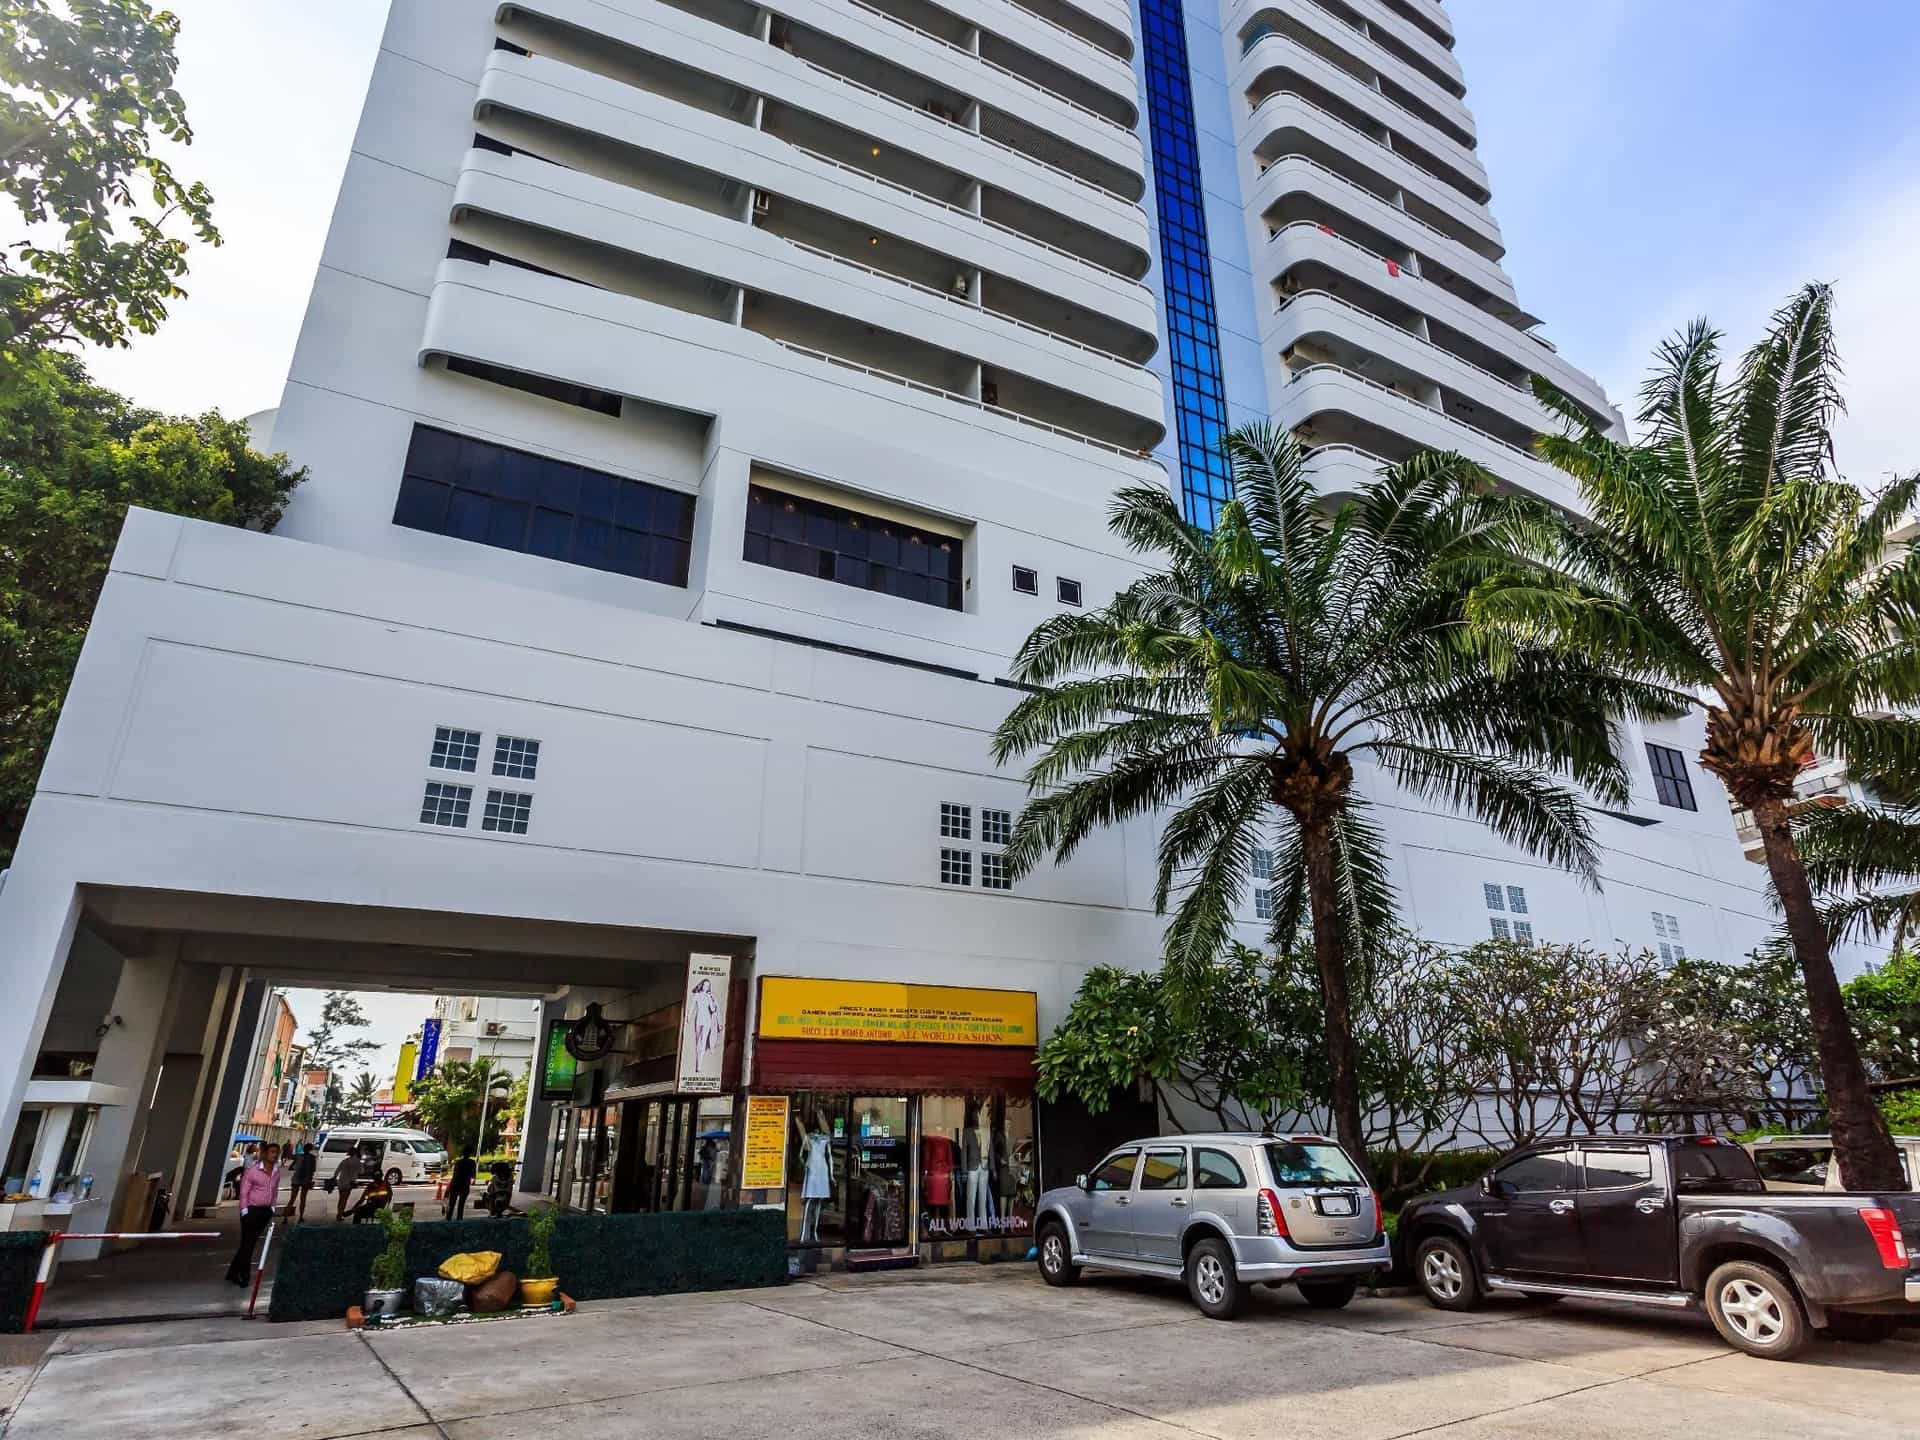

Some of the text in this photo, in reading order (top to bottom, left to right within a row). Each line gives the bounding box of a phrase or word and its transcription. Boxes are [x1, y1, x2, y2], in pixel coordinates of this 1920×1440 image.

[921, 1031, 956, 1041] WORLD
[958, 1032, 1002, 1041] FASHION
[929, 1218, 946, 1231] ALL
